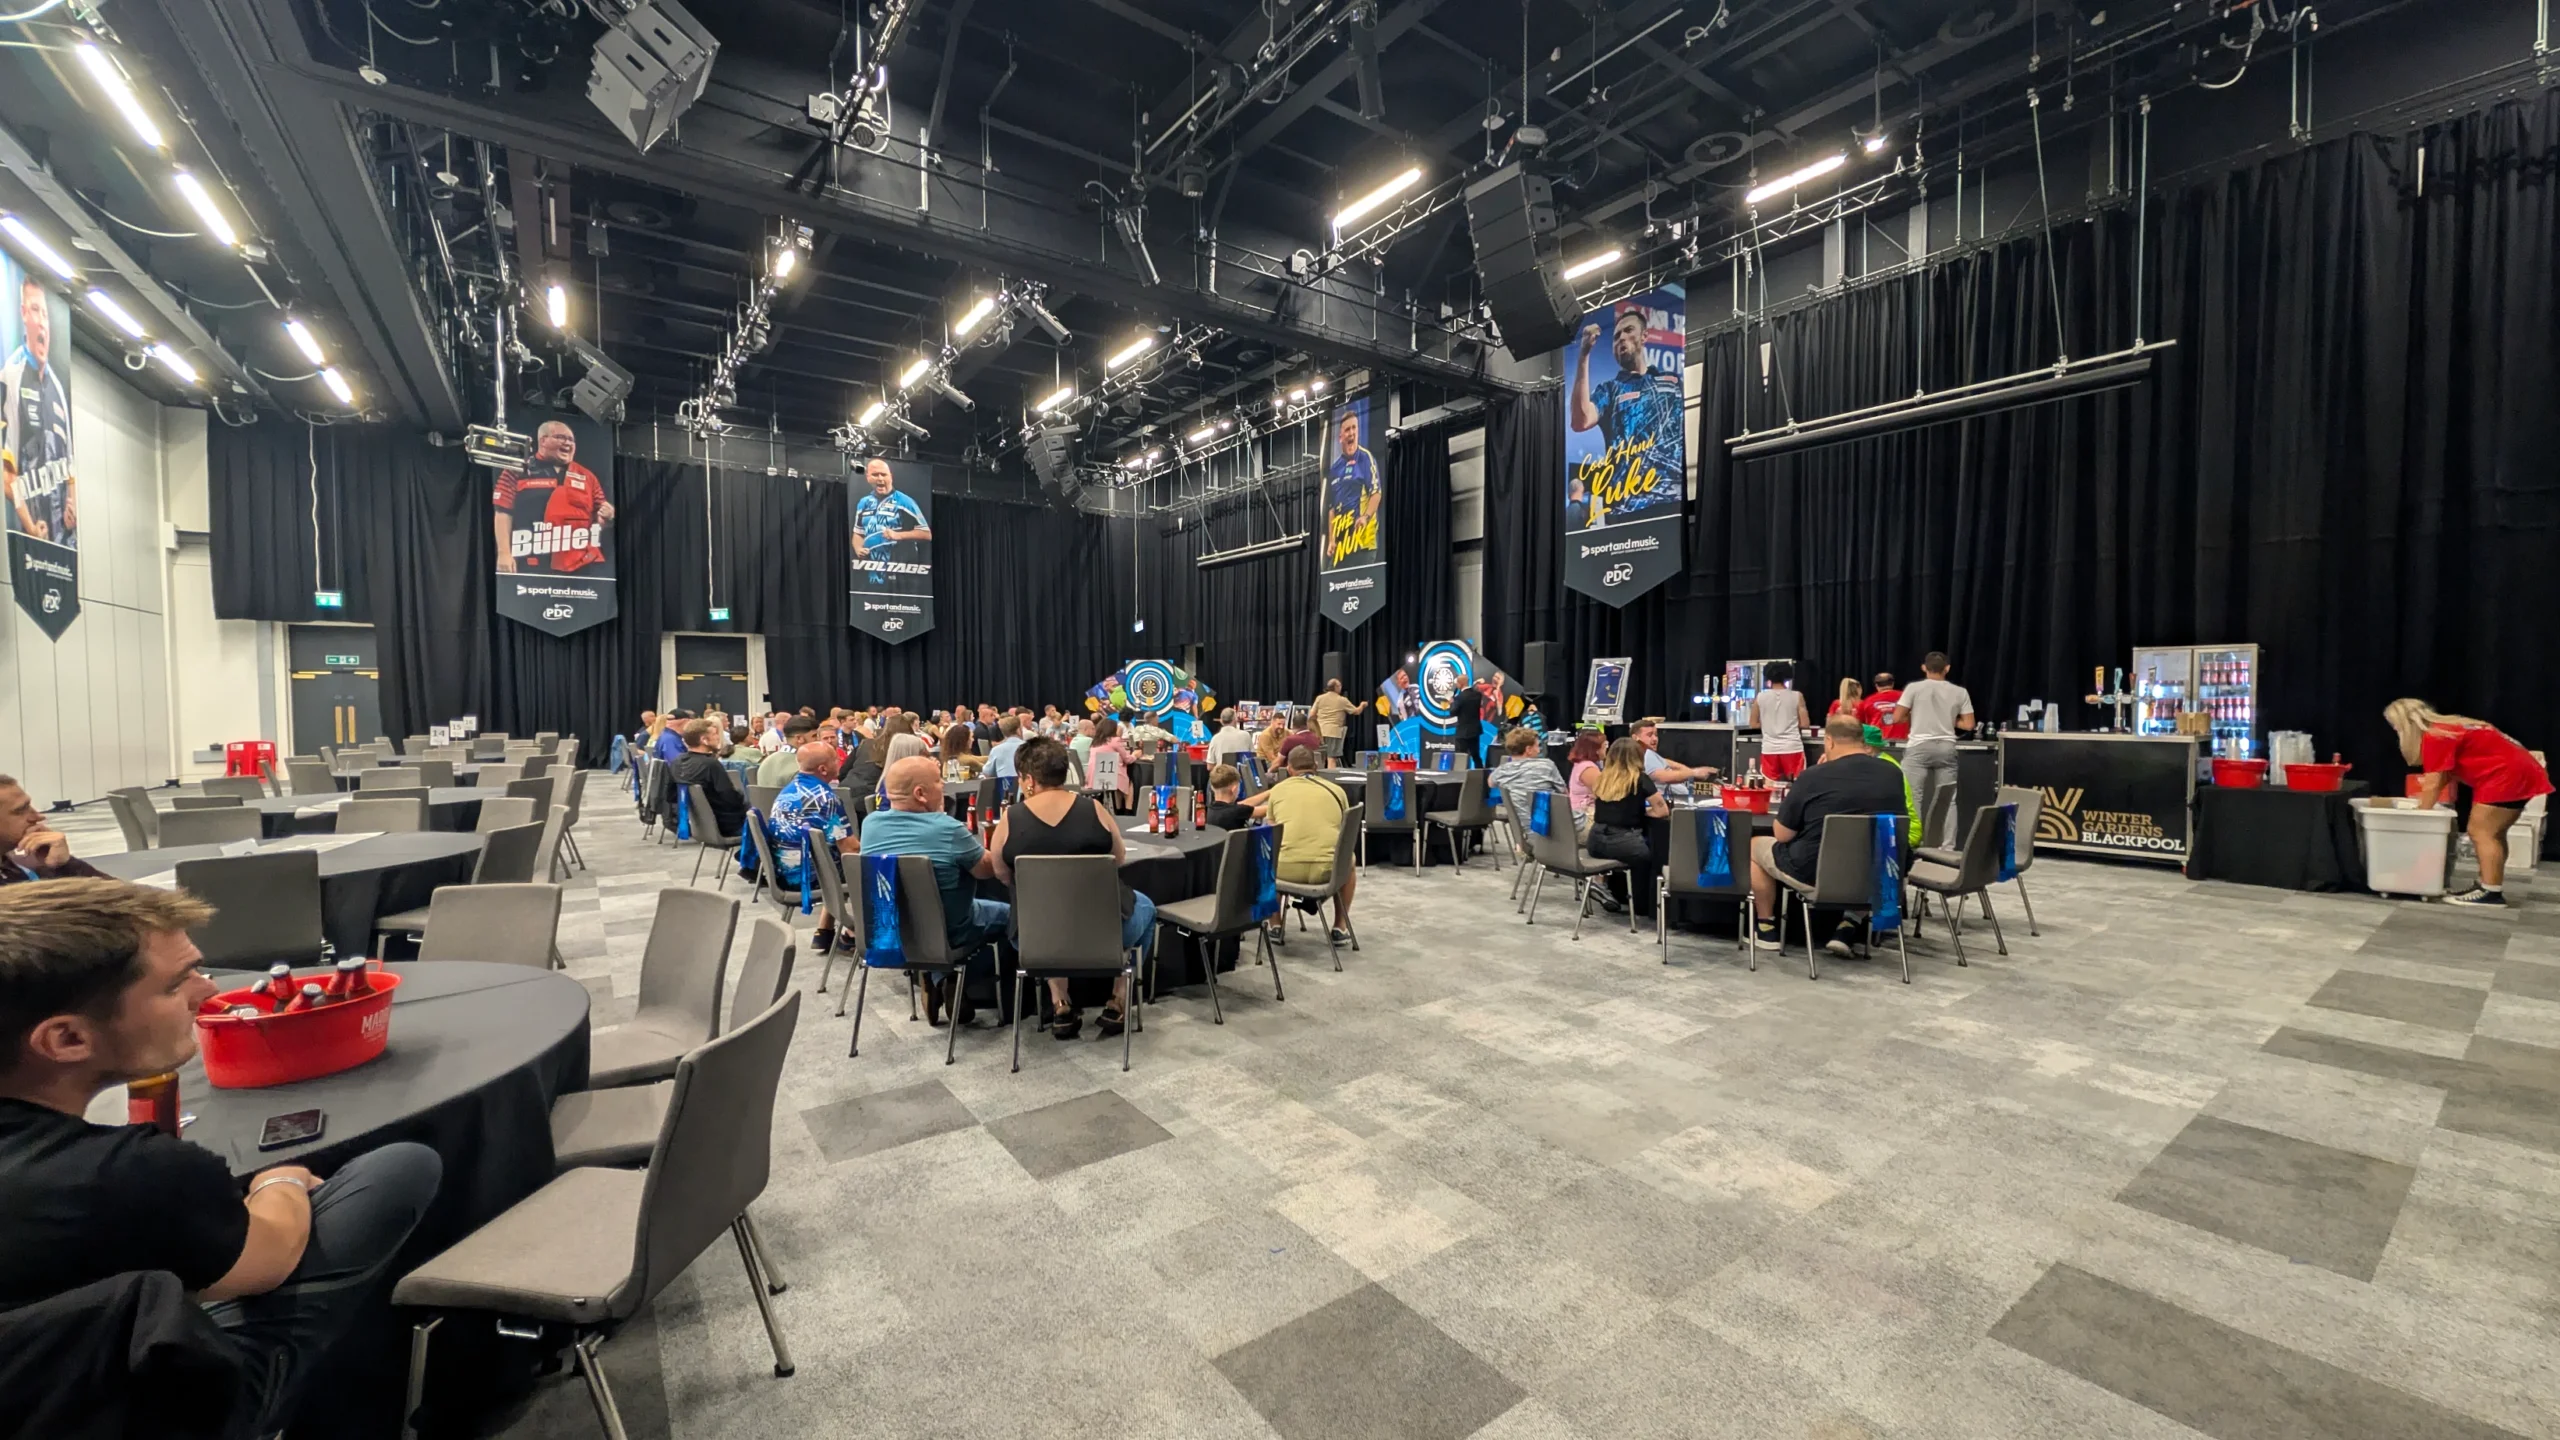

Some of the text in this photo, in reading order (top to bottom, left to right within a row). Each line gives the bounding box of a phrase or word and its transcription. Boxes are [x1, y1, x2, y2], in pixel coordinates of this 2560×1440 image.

[1579, 431, 1656, 481] Cool Hand
[1586, 457, 1662, 528] Luke
[532, 521, 553, 532] The
[1331, 509, 1355, 538] THE
[511, 523, 602, 557] Bullet
[1333, 520, 1379, 567] NUKE
[852, 559, 932, 575] VOLTAGE
[1605, 567, 1631, 584] PDC
[545, 606, 573, 619] PDC
[1343, 599, 1359, 612] PDC
[884, 620, 903, 630] PDC
[432, 729, 445, 737] 14
[1099, 760, 1115, 773] 11
[2082, 810, 2153, 826] WINTER
[2082, 822, 2164, 838] GARDENS
[2082, 831, 2186, 851] BLACKPOOL
